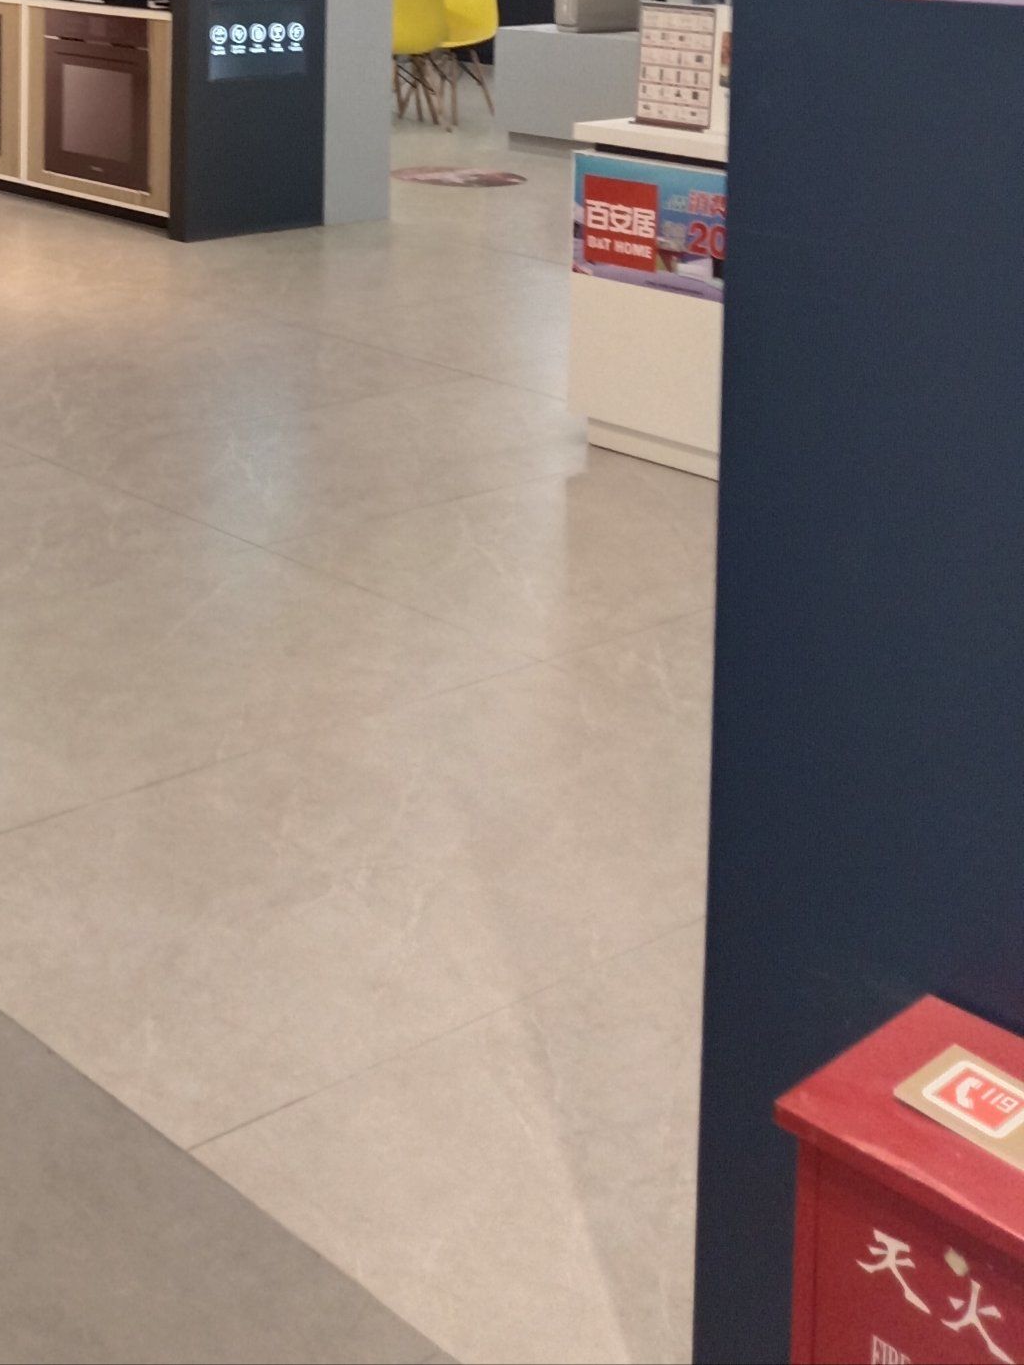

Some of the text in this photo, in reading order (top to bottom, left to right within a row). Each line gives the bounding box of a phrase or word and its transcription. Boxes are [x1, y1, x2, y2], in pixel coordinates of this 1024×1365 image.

[585, 198, 657, 239] 百安居
[613, 239, 653, 260] HOME
[980, 1087, 1020, 1114] 119
